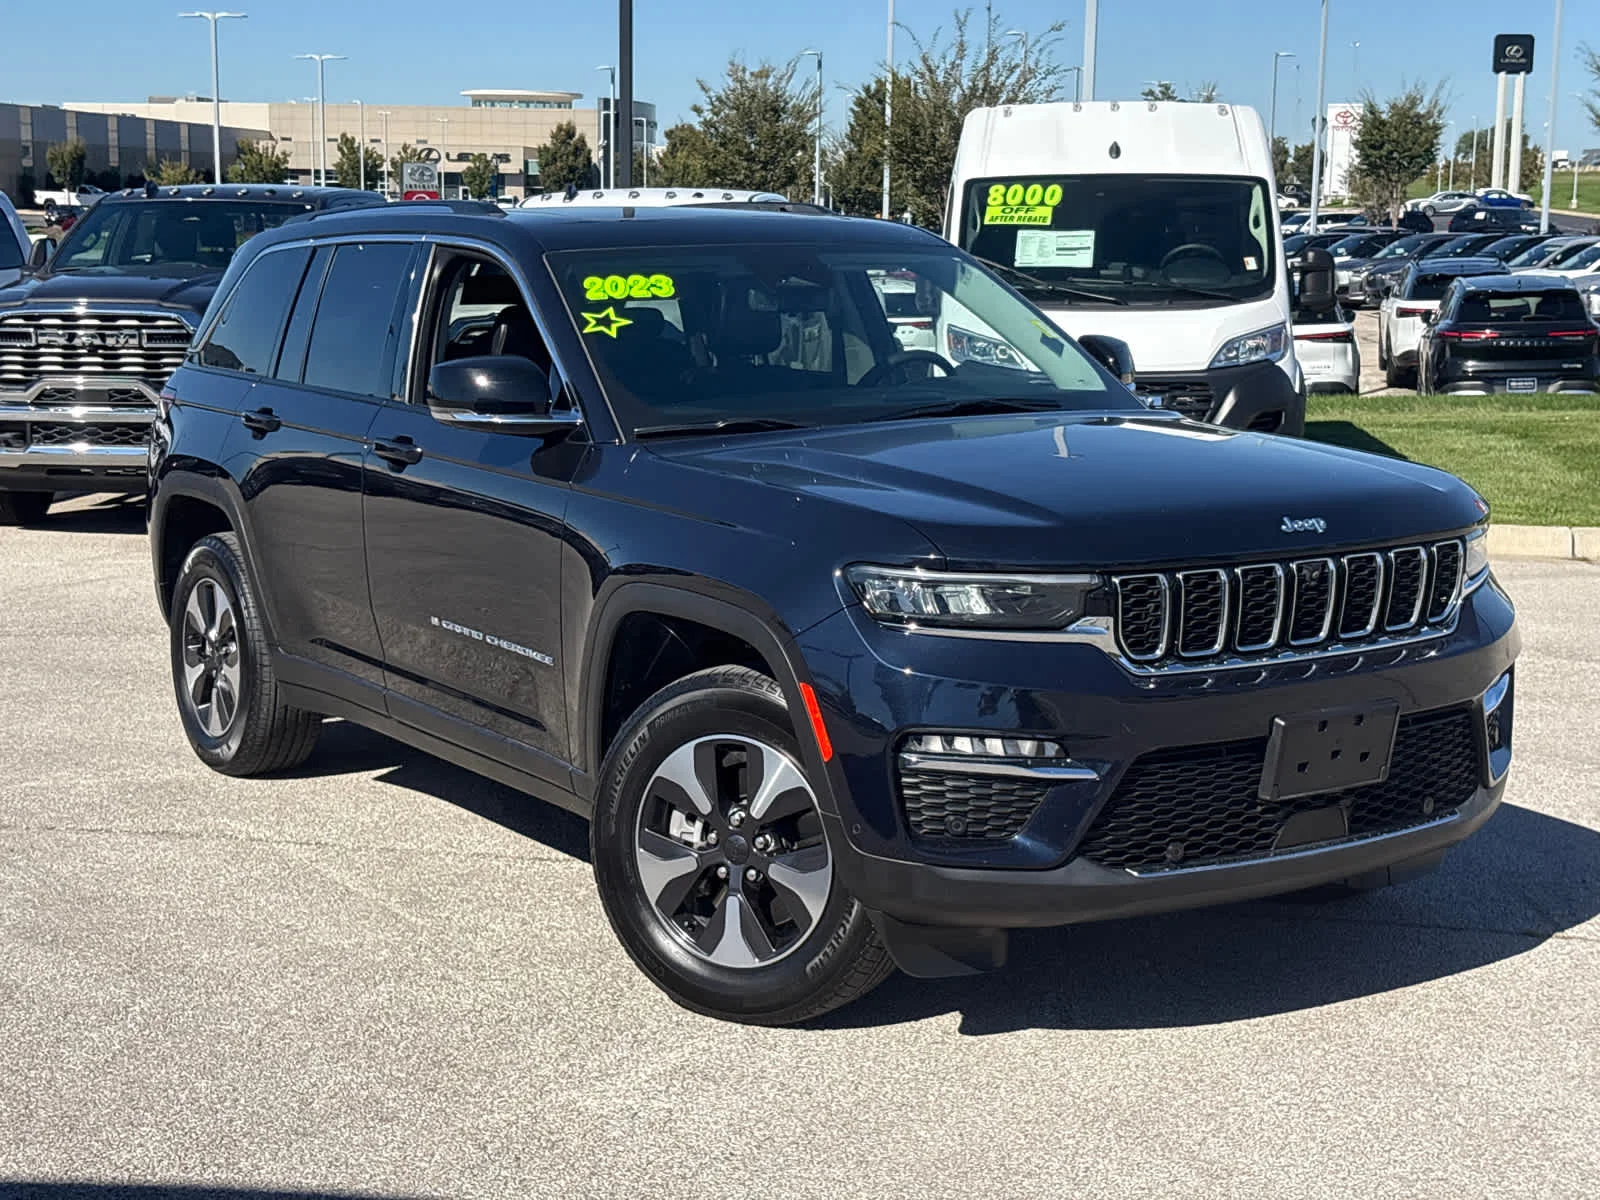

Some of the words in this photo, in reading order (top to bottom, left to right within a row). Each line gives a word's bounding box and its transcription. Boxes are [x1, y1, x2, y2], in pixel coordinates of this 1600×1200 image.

[987, 184, 1063, 206] 8000
[583, 274, 675, 300] 2023
[37, 330, 139, 346] RAM
[1281, 516, 1327, 533] Jeep
[441, 619, 483, 641] GRAND
[485, 634, 554, 666] CHEROKEE
[608, 724, 650, 816] MICHELIN
